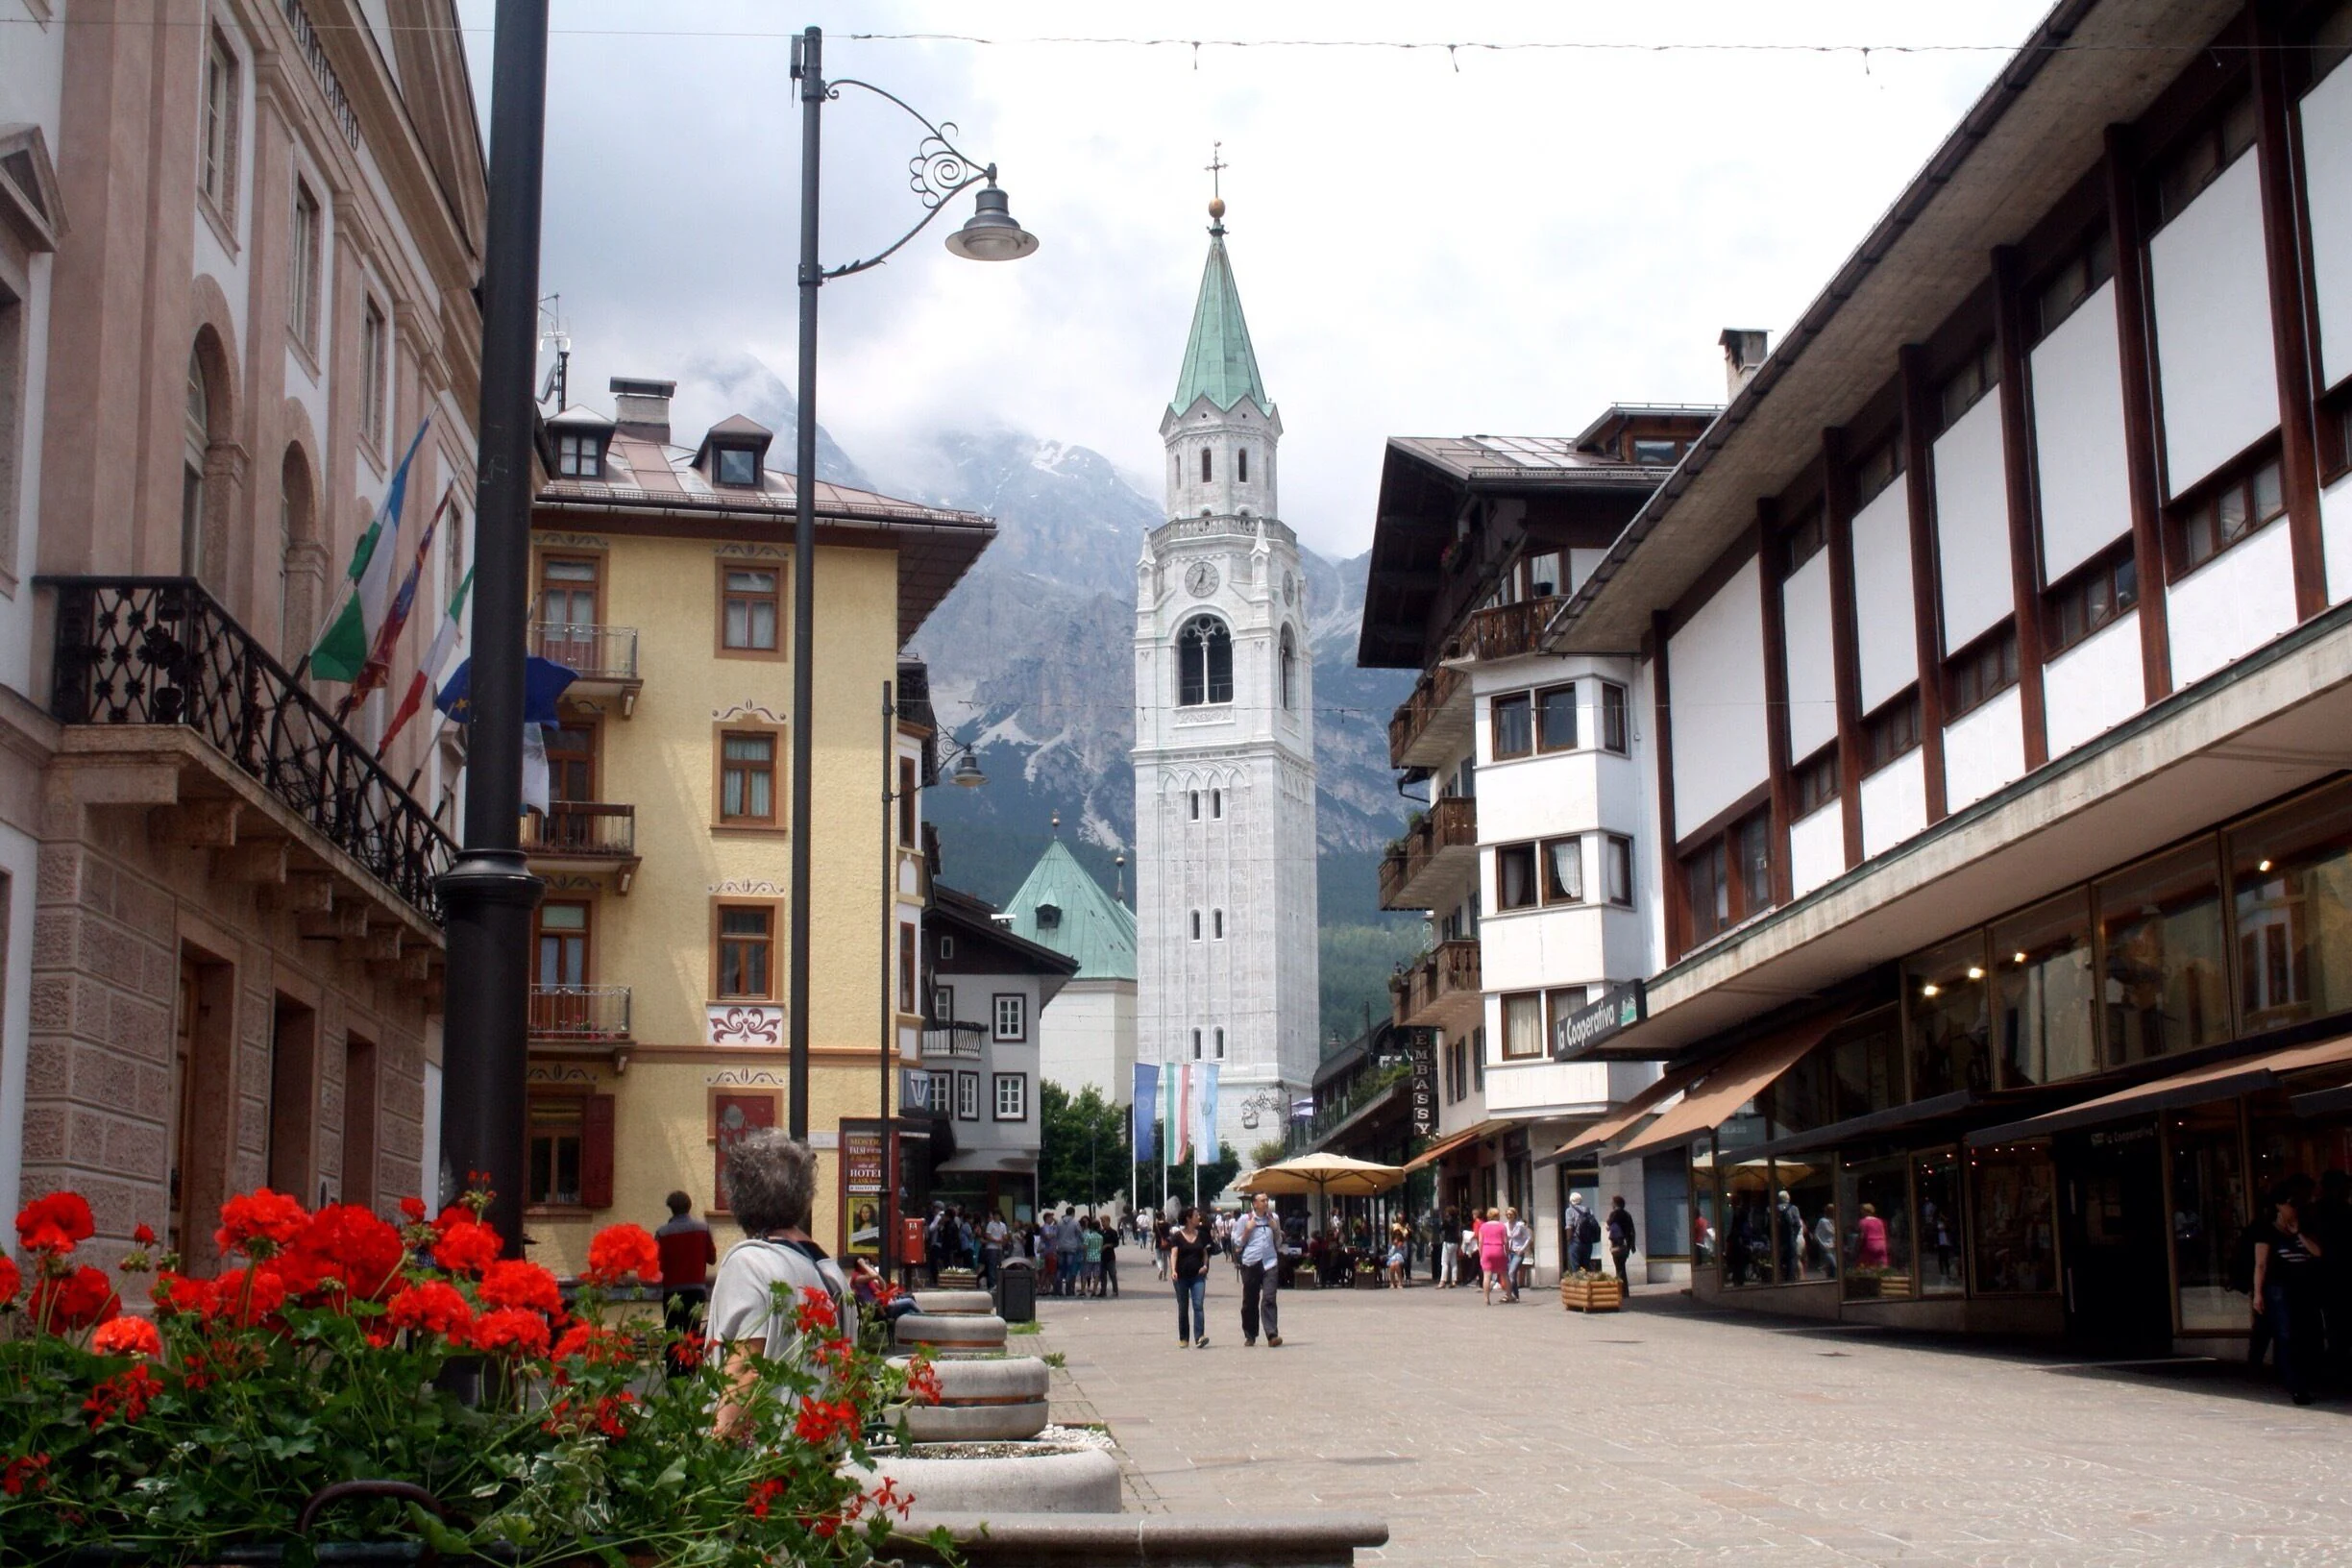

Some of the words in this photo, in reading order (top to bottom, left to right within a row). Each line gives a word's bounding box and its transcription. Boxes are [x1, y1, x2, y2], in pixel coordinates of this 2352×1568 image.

[1557, 1023, 1565, 1051] la
[1567, 999, 1614, 1046] Cooperativa
[1415, 1035, 1430, 1135] EMBASSY
